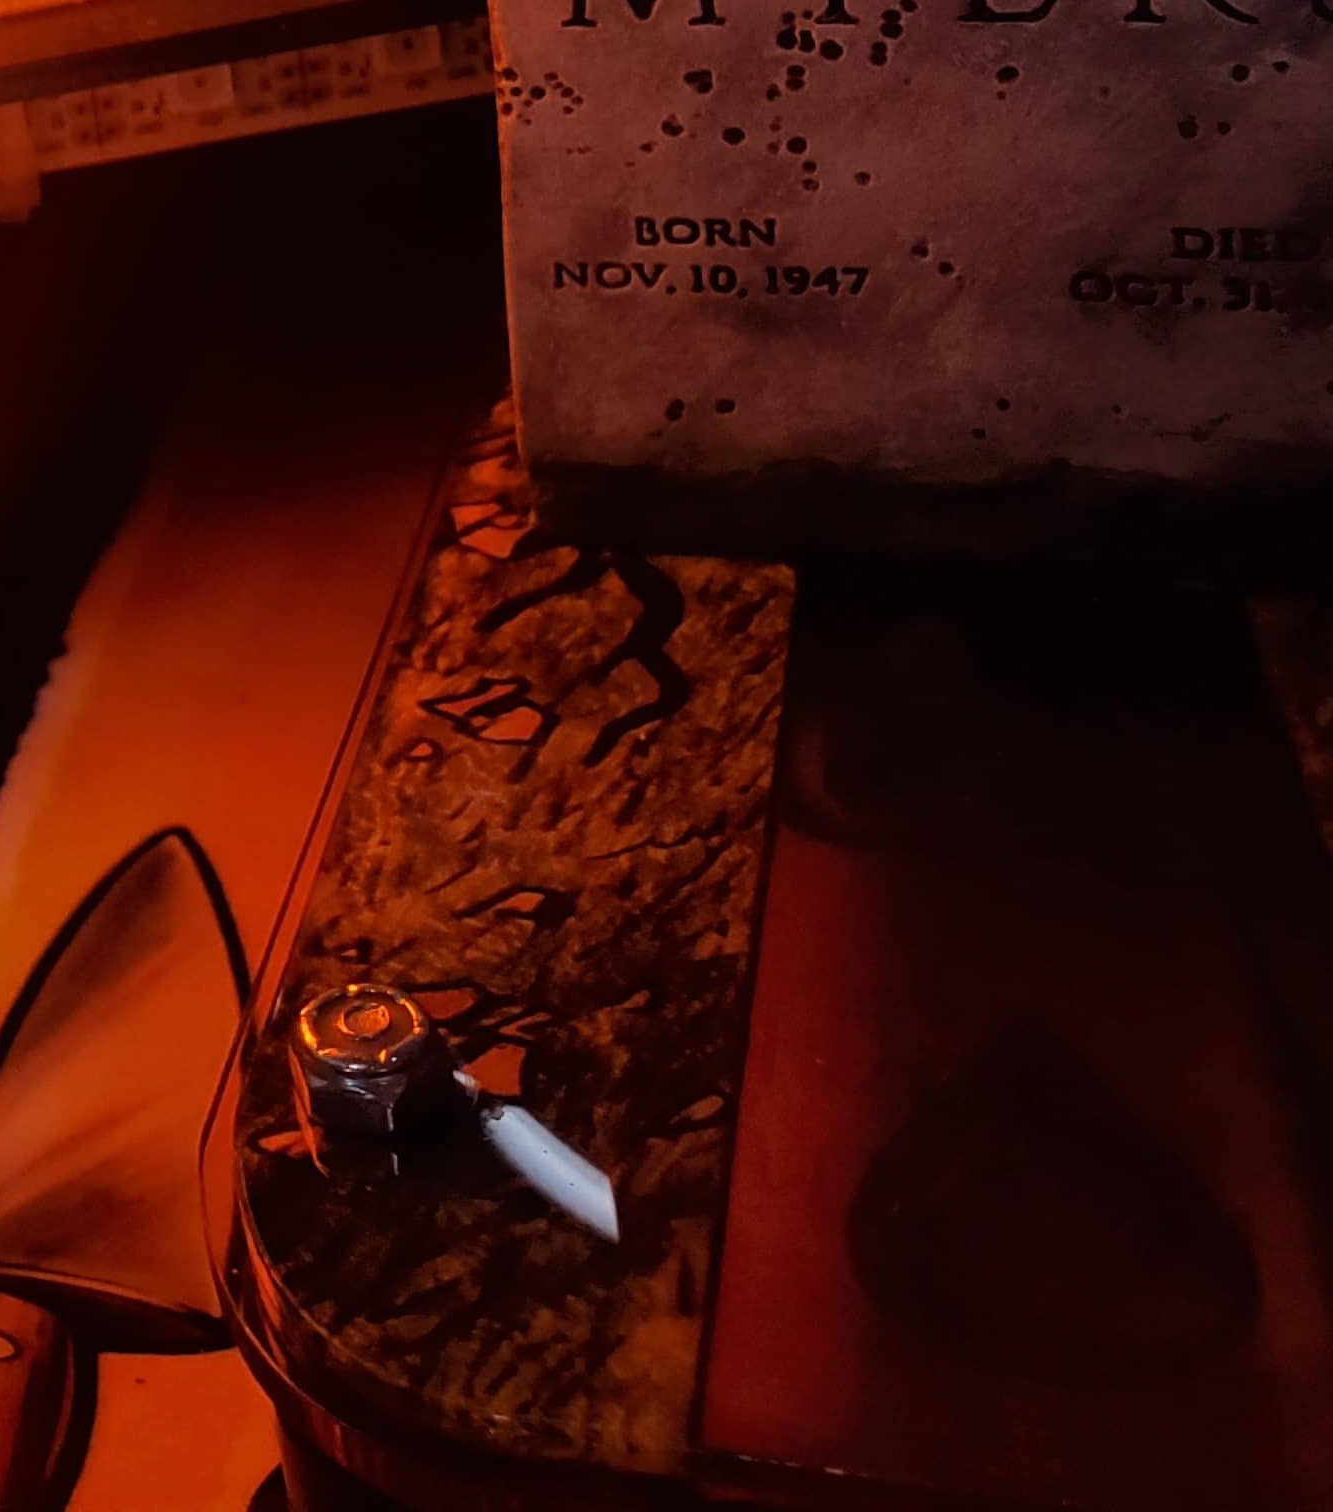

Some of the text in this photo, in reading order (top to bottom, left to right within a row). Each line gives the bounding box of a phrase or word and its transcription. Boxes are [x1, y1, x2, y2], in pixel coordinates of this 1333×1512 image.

[634, 217, 777, 247] BORN
[1171, 227, 1319, 261] DIED
[554, 264, 677, 294] NOV.
[764, 267, 870, 296] 1947
[1070, 271, 1205, 306] OCT.
